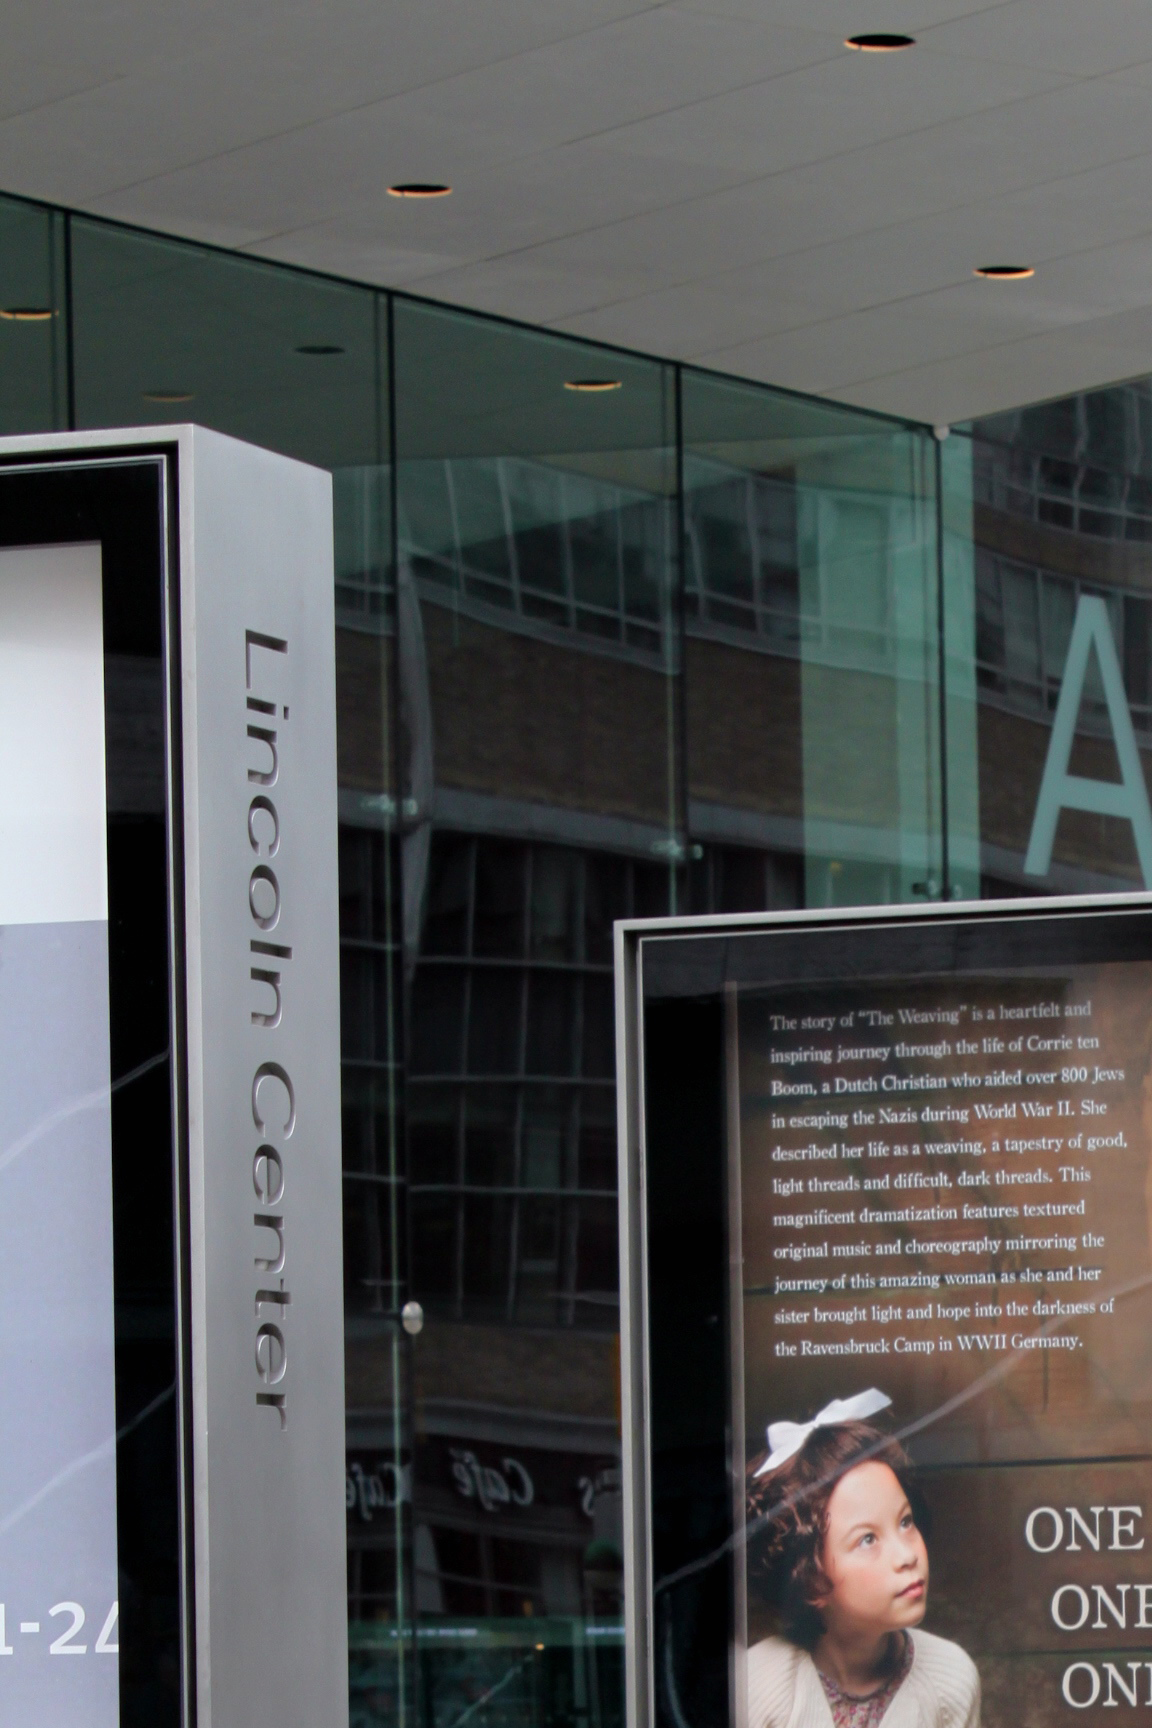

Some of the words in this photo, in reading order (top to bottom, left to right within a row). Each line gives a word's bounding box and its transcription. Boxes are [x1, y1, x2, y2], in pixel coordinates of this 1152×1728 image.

[245, 627, 292, 1029] Lincoln
[769, 1014, 797, 1030] The
[800, 1012, 836, 1034] story
[839, 1012, 854, 1027] of
[857, 1010, 894, 1026] “The
[897, 1006, 967, 1029] Weaving”
[971, 1006, 983, 1021] is
[986, 1009, 995, 1020] a
[999, 1002, 1060, 1020] heartfelt
[1064, 1001, 1092, 1017] and
[770, 1045, 832, 1068] inspiring
[836, 1047, 890, 1065] journey
[894, 1040, 951, 1062] through
[955, 1039, 978, 1055] the
[982, 1038, 1005, 1054] life
[1008, 1037, 1023, 1053] of
[1026, 1035, 1073, 1052] Corrie
[1076, 1033, 1099, 1049] ten
[770, 1079, 817, 1100] Boom,
[821, 1082, 830, 1093] a
[834, 1076, 877, 1093] Dutch
[880, 1073, 947, 1091] Christian
[950, 1072, 981, 1088] who
[984, 1070, 1022, 1086] aided
[1025, 1073, 1057, 1085] over
[1061, 1067, 1088, 1083] 800
[1091, 1065, 1124, 1082] Jews
[771, 1113, 785, 1128] in
[788, 1110, 848, 1132] escaping
[852, 1109, 875, 1125] the
[878, 1107, 917, 1124] Nazis
[920, 1105, 969, 1126] during
[973, 1103, 1016, 1120] World
[1021, 1101, 1053, 1118] War
[1057, 1100, 1075, 1116] II.
[1080, 1099, 1107, 1115] She
[248, 1061, 296, 1431] Center
[1025, 1505, 1144, 1552] ONE
